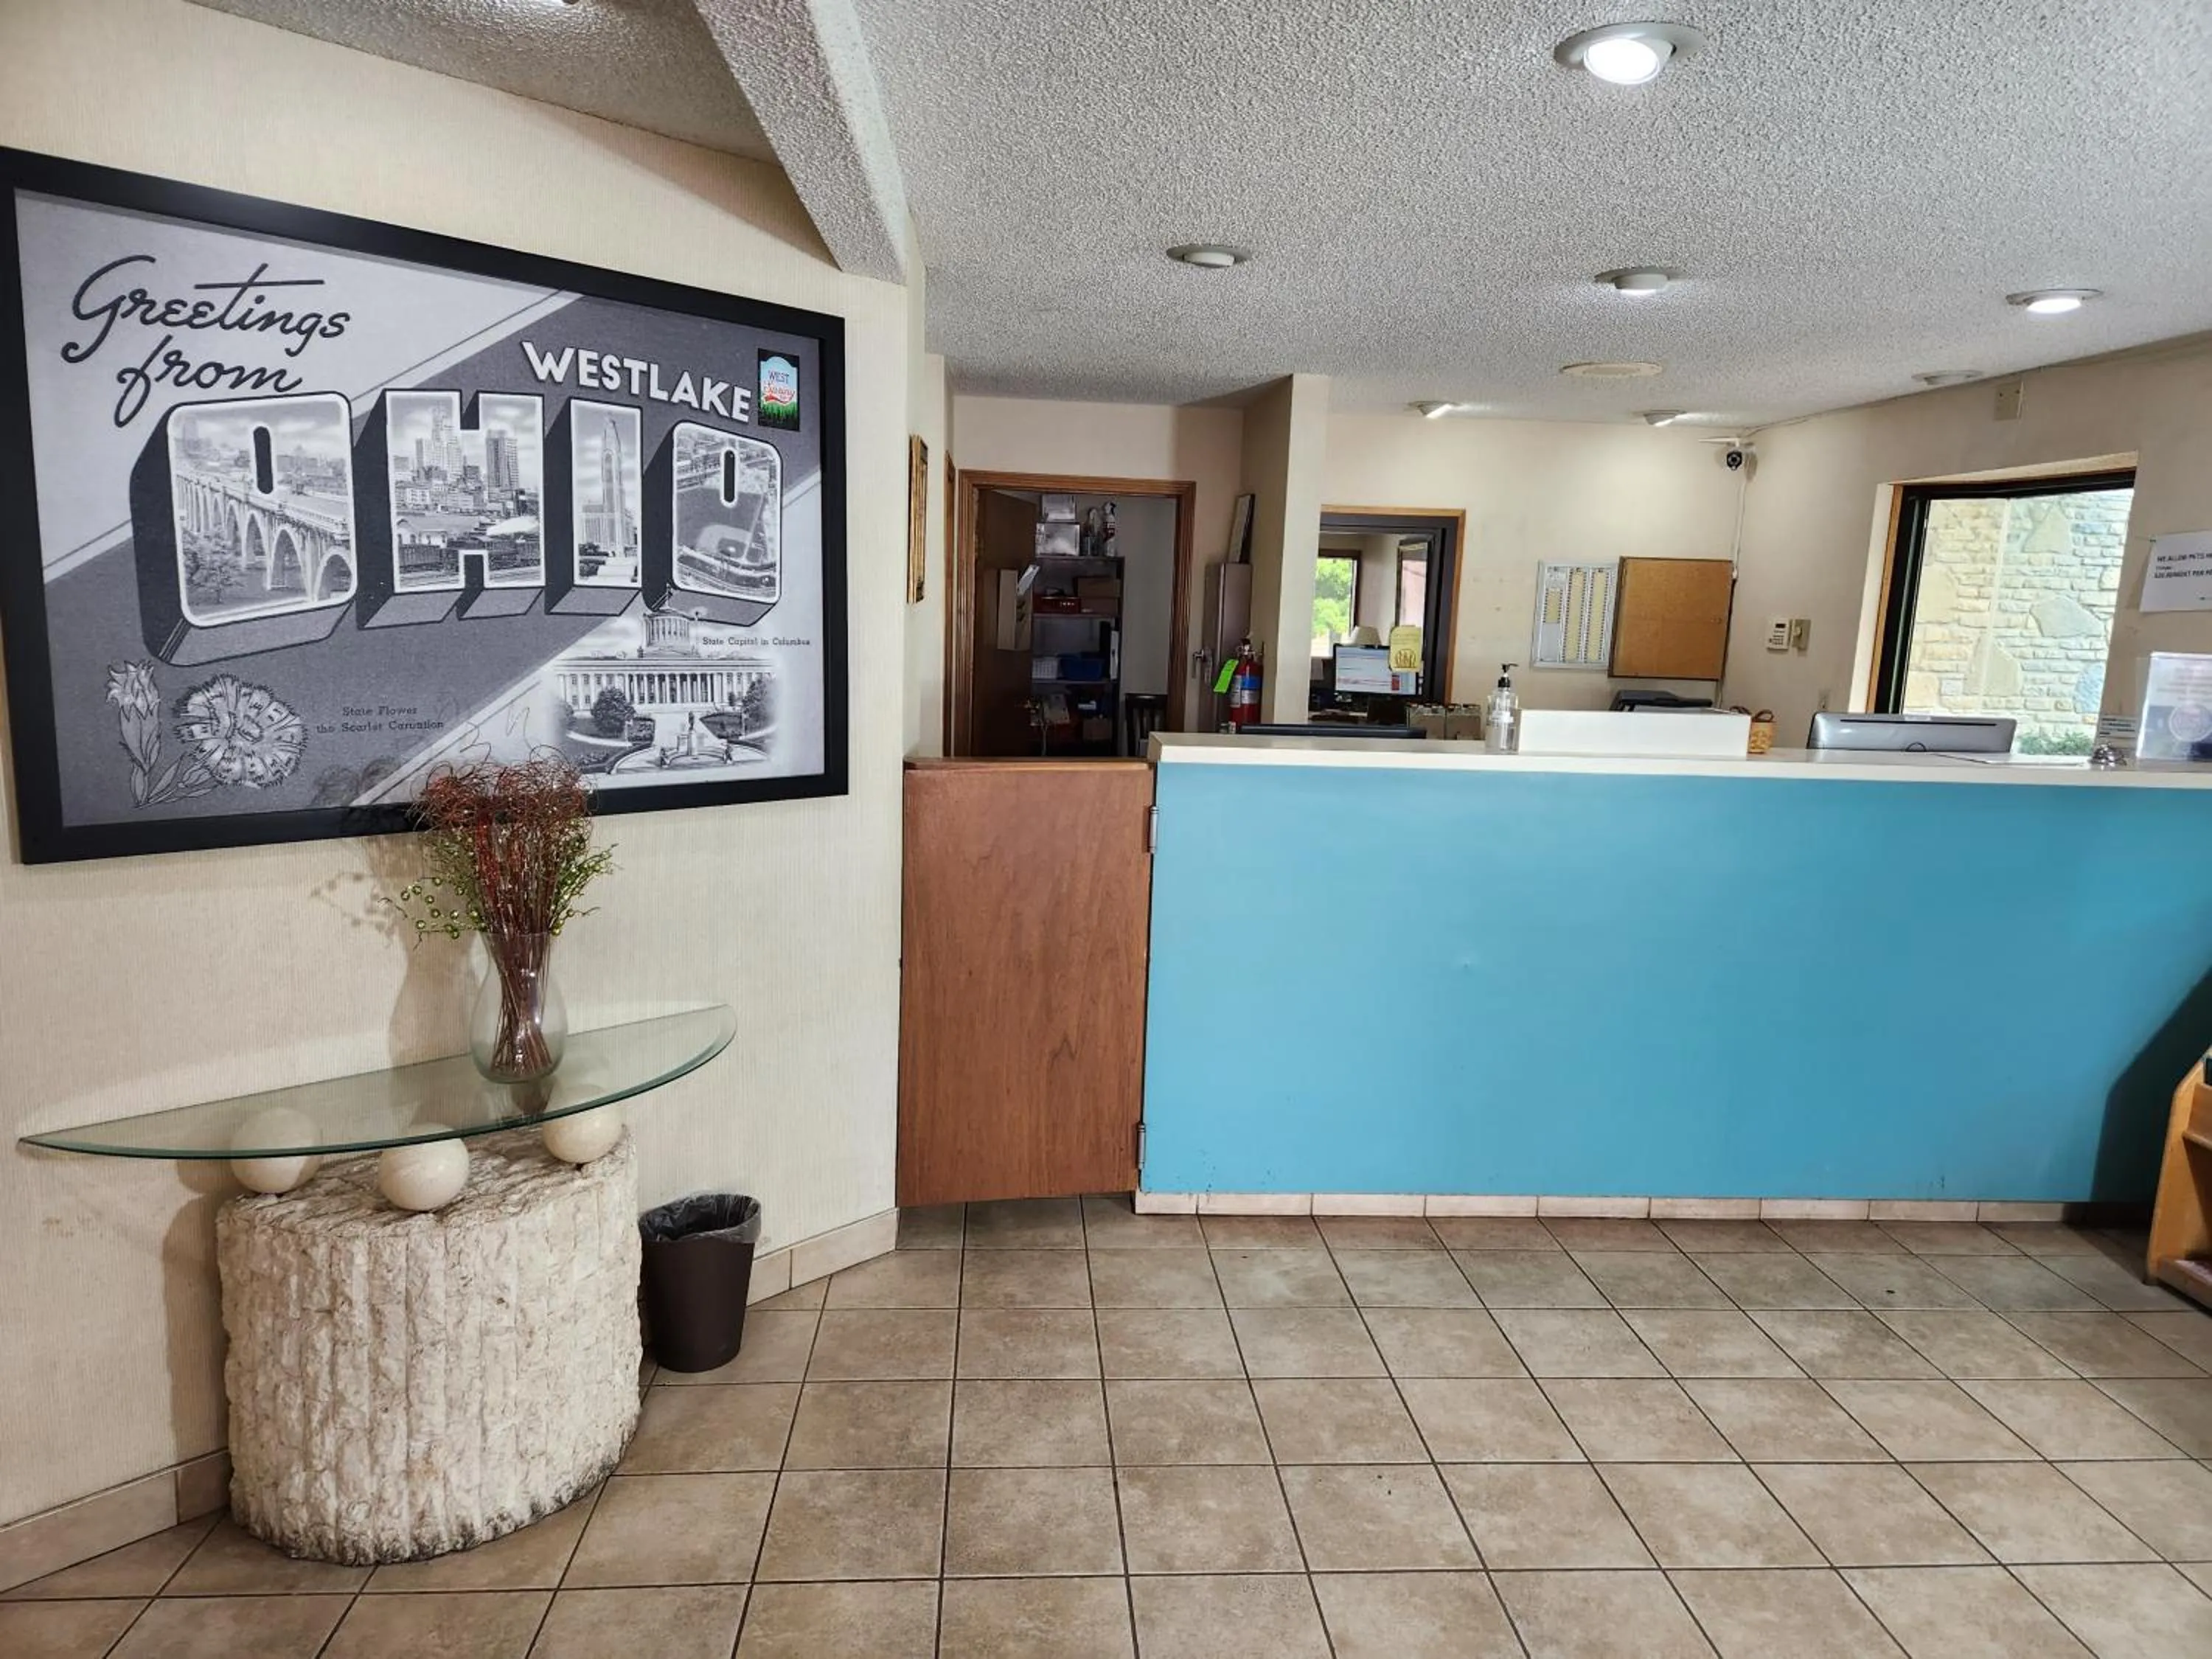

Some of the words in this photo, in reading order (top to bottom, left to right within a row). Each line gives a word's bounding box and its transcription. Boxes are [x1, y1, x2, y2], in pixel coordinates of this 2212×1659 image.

[61, 254, 350, 357] Greetings
[114, 334, 302, 428] from
[521, 341, 752, 423] WESTLAKE
[164, 387, 783, 634] OHIO
[702, 637, 724, 646] State
[761, 637, 769, 646] in
[772, 637, 811, 646] Columbus
[316, 724, 335, 734] the
[341, 722, 383, 733] Scarlet
[389, 720, 444, 731] Carnation
[342, 706, 374, 717] State
[378, 706, 418, 716] Flower
